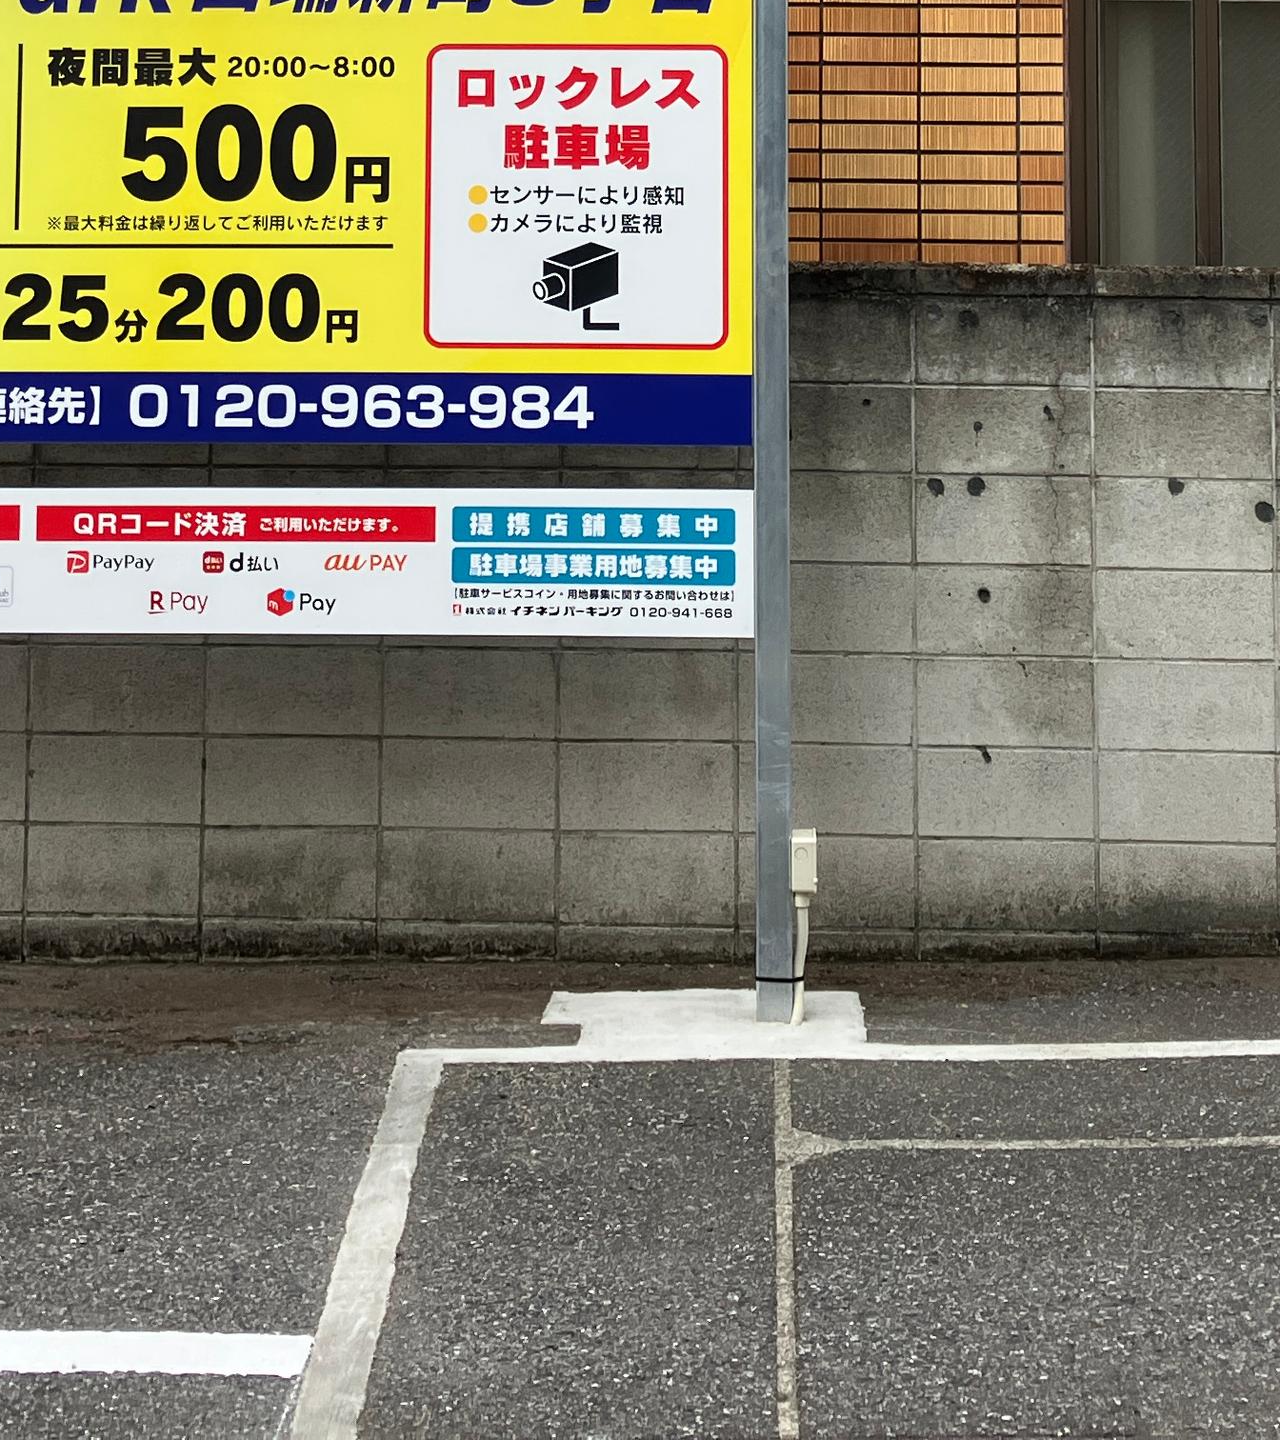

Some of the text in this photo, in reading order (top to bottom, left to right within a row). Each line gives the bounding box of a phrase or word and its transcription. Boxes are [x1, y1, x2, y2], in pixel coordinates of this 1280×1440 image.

[47, 47, 217, 86] 夜間最大
[458, 66, 700, 110] ロックレス
[122, 104, 391, 204] 500円
[504, 124, 650, 169] 駐車場
[490, 186, 684, 205] センサーにより感知
[491, 214, 662, 234] カメラにより監視
[130, 385, 594, 428] 0120-963-984
[74, 512, 398, 536] QRコード決済 ご利用いただけます。
[470, 513, 718, 538] 提携店舗募集中
[94, 555, 154, 571] PayPay
[230, 552, 278, 572] d払い
[325, 555, 407, 571] au PAY
[470, 553, 718, 579] 駐車場事業用地募集中
[147, 591, 208, 614] R Pay
[300, 593, 335, 615] Pay
[630, 607, 732, 618] 0120-941-668
